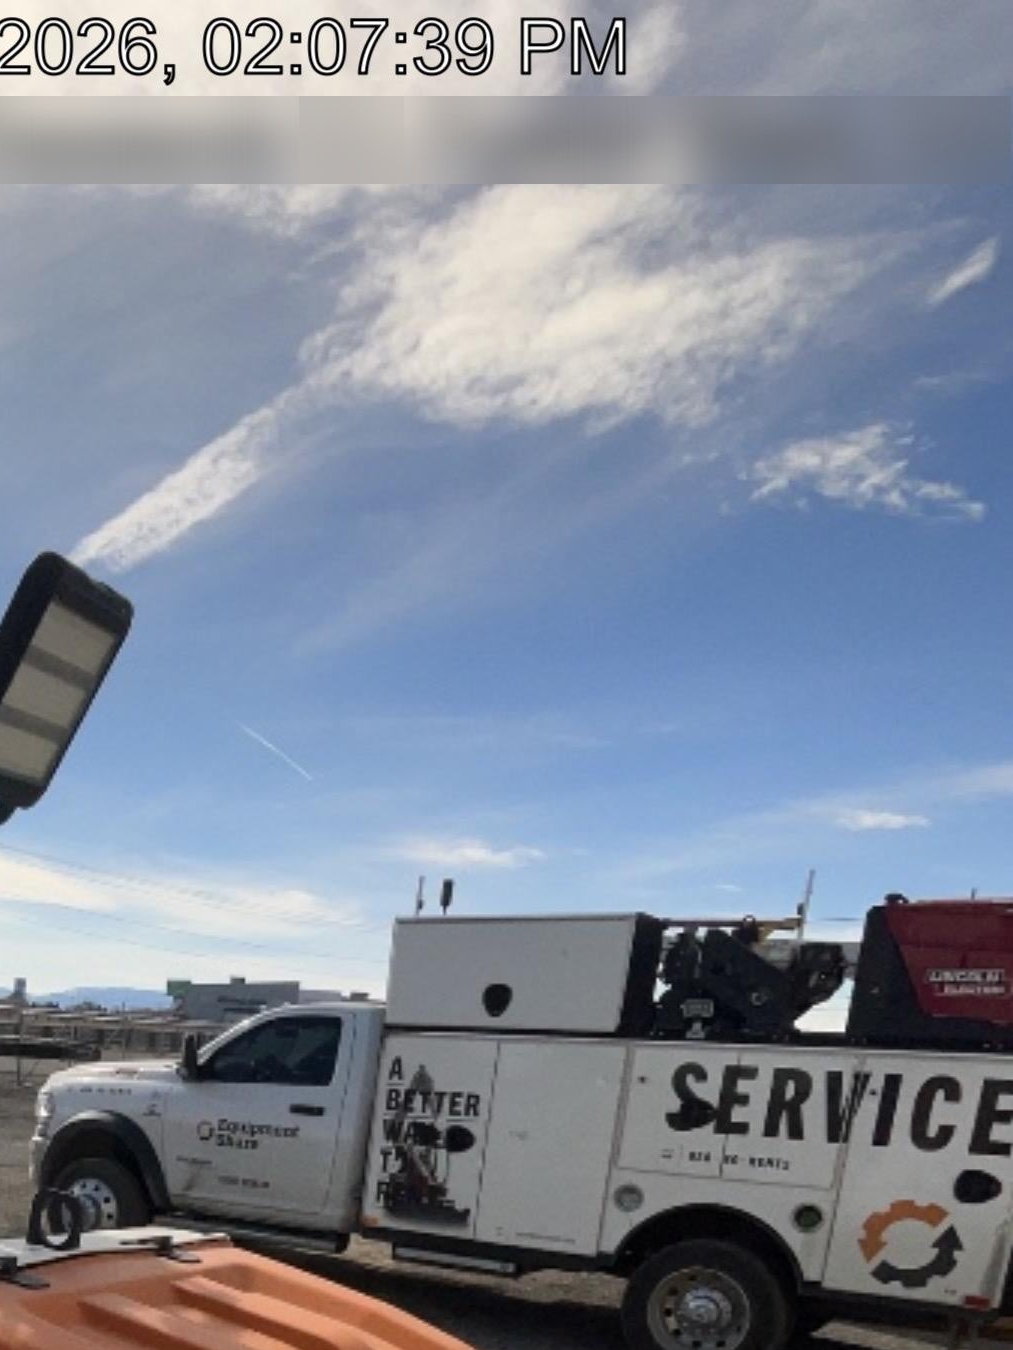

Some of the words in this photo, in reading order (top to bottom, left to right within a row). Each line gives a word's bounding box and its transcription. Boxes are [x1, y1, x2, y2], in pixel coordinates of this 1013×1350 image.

[388, 1055, 404, 1081] A
[385, 1087, 481, 1117] BETTER
[664, 1061, 1013, 1157] SERVICE
[216, 1117, 301, 1138] Equipment
[215, 1133, 260, 1150] Share
